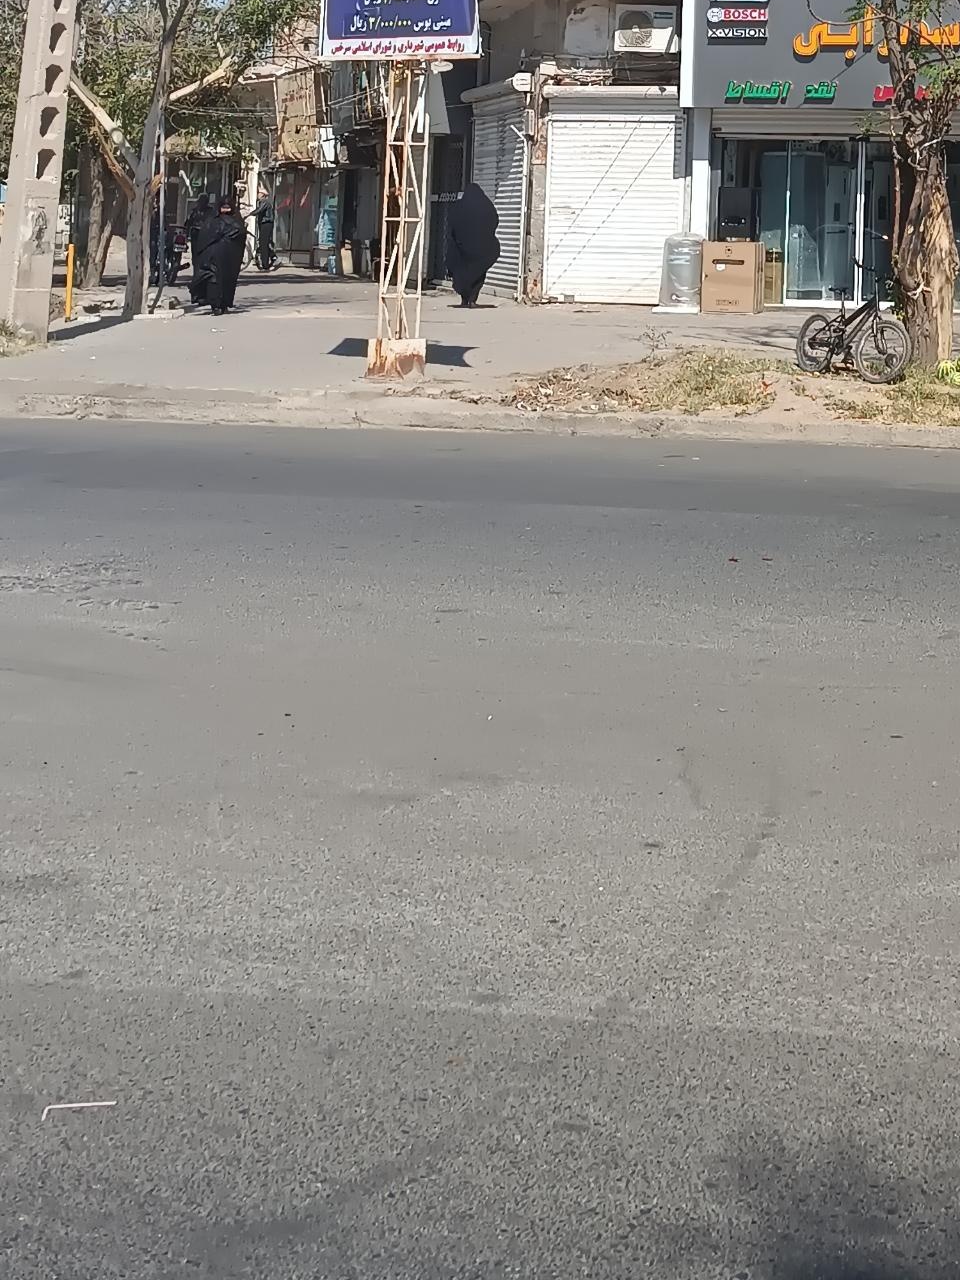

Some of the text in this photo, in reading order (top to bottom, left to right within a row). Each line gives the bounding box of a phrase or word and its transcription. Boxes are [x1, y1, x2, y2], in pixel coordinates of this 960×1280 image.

[350, 14, 367, 31] ریال
[722, 8, 767, 20] BOSCH
[725, 80, 838, 99] نقد اقساط
